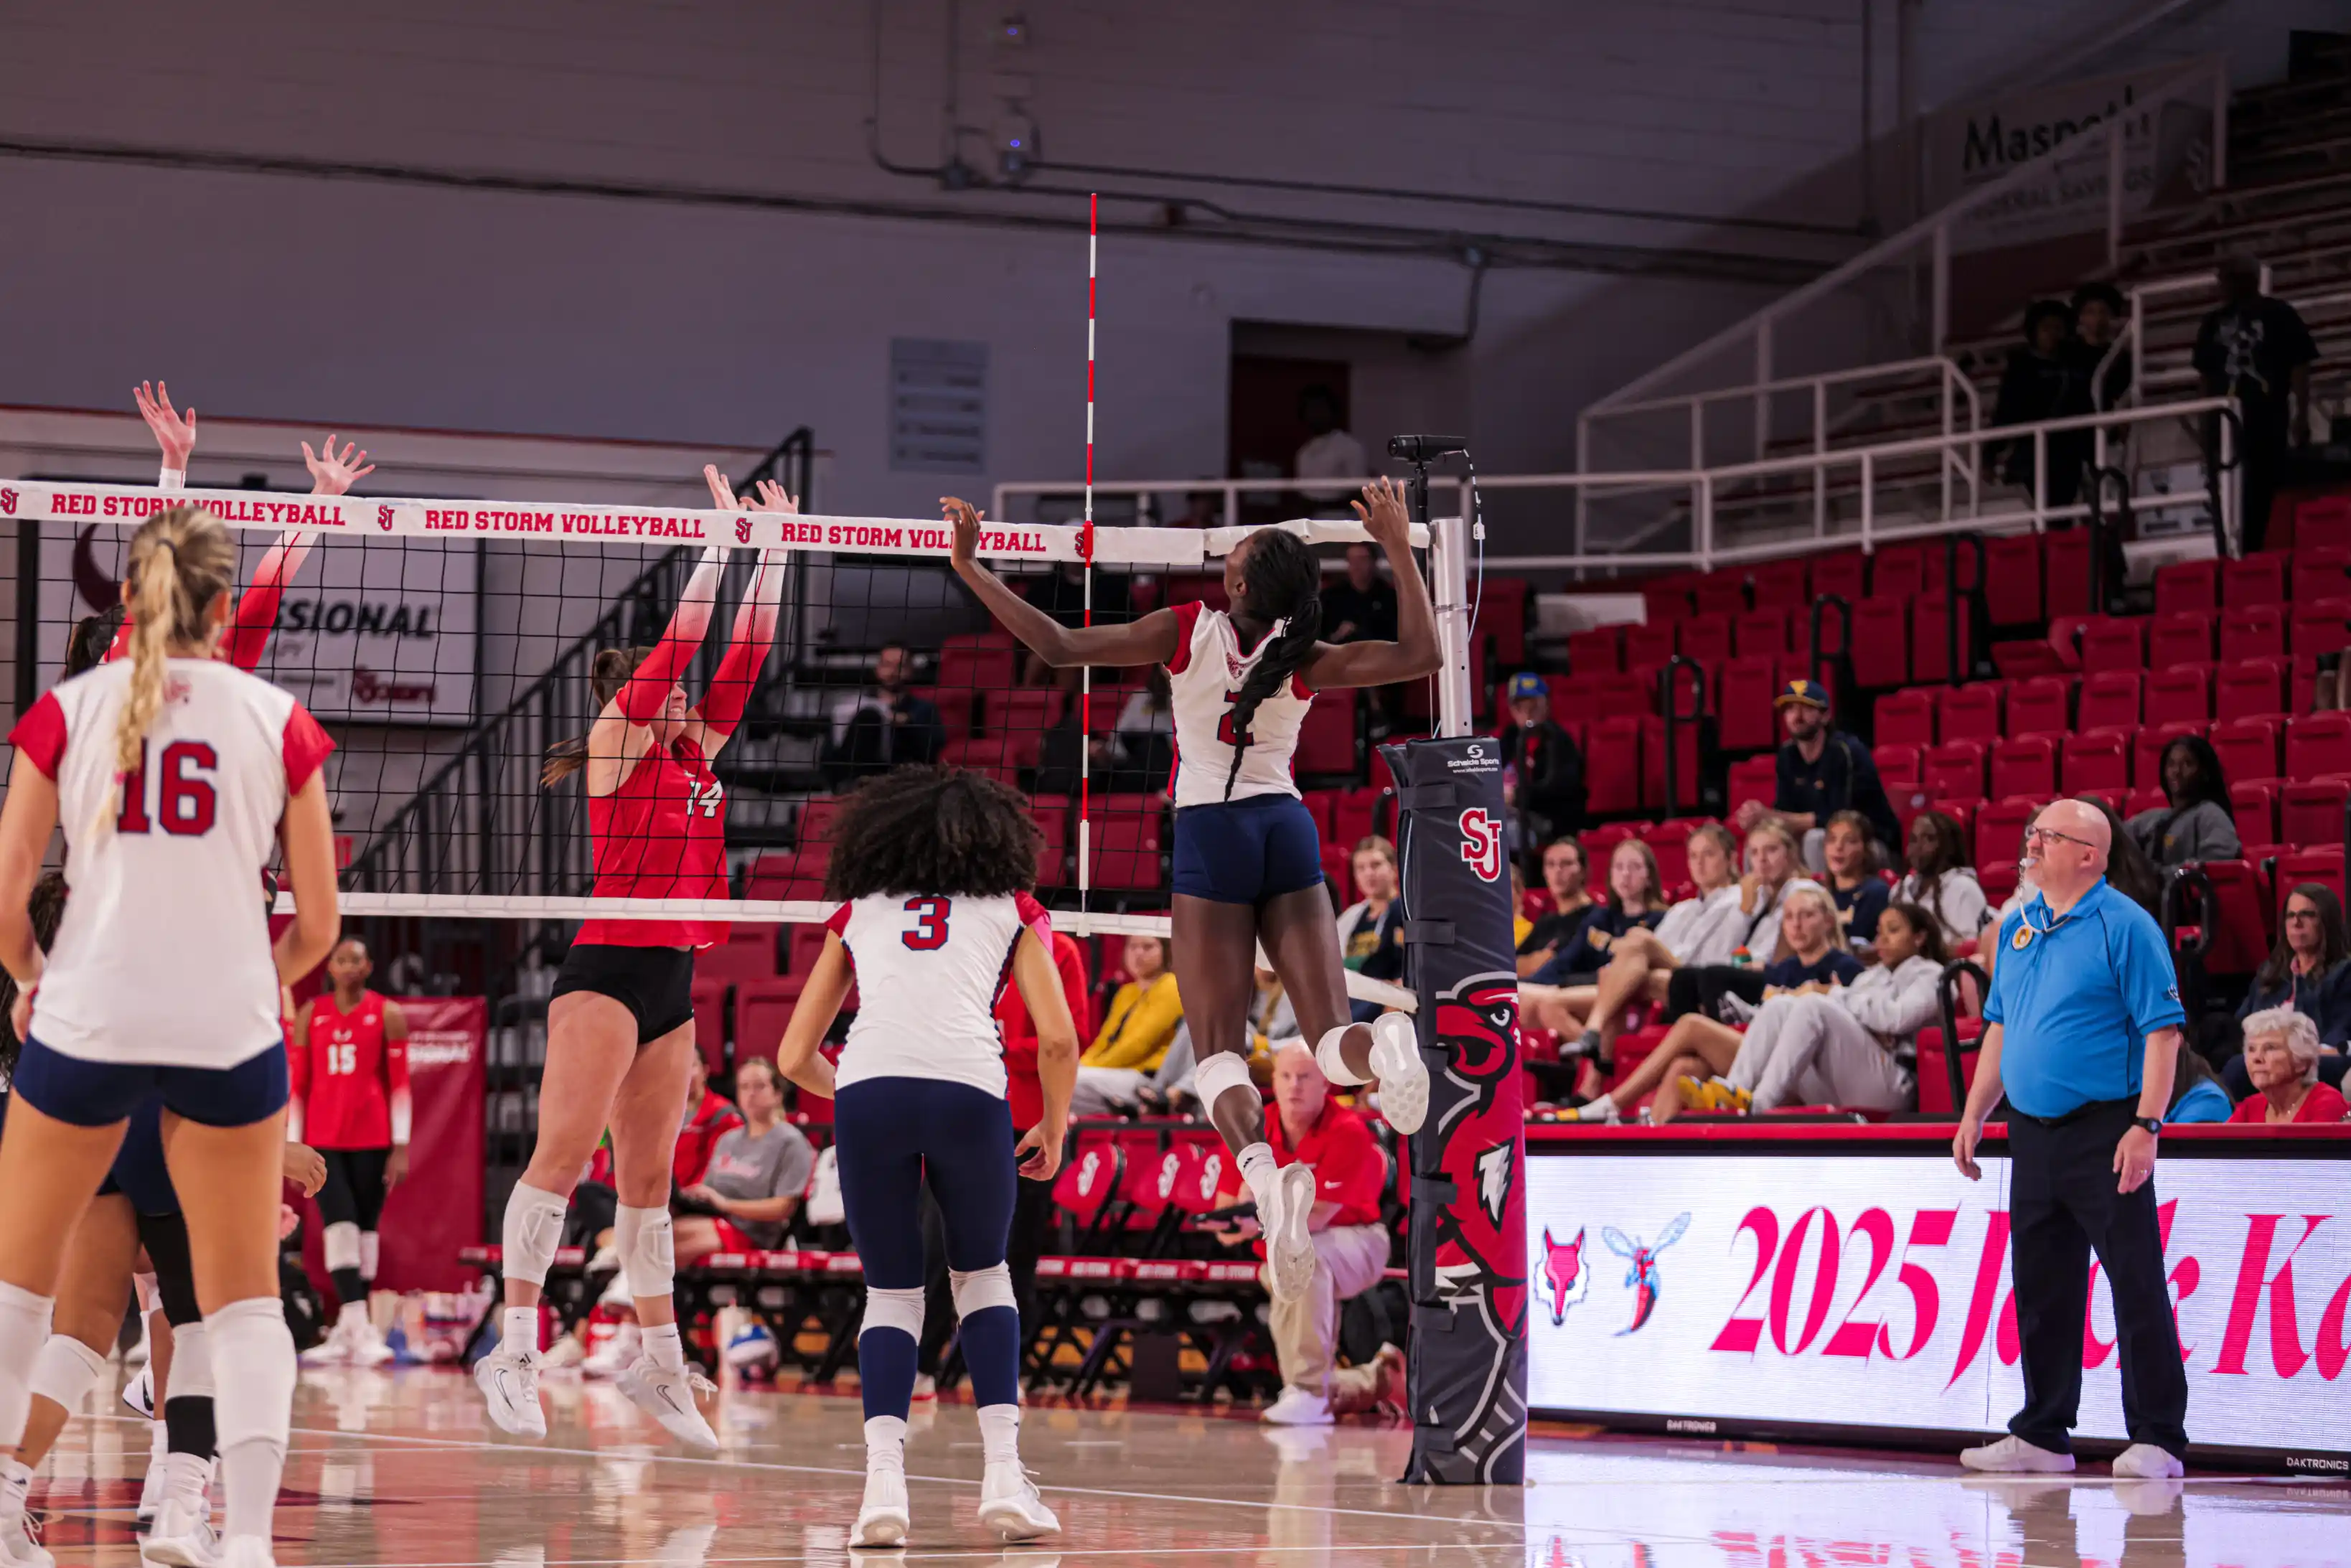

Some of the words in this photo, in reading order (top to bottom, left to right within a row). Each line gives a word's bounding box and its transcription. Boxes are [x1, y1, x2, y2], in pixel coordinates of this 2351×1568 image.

[1963, 83, 2151, 172] Masph
[51, 494, 97, 515] RED
[103, 496, 185, 517] STORM
[426, 510, 469, 530] RED
[474, 511, 554, 532] STORM
[561, 514, 705, 538] VOLLEYBALL
[782, 522, 822, 543] RED
[828, 525, 903, 548] STORM
[909, 529, 1046, 553] VOLYBALL
[117, 736, 218, 837] 16
[687, 779, 723, 818] 14
[901, 894, 952, 951] 3
[327, 1043, 357, 1076] 15
[1707, 1200, 1961, 1366] 2025
[2286, 1457, 2350, 1471] DAKTRONICS
